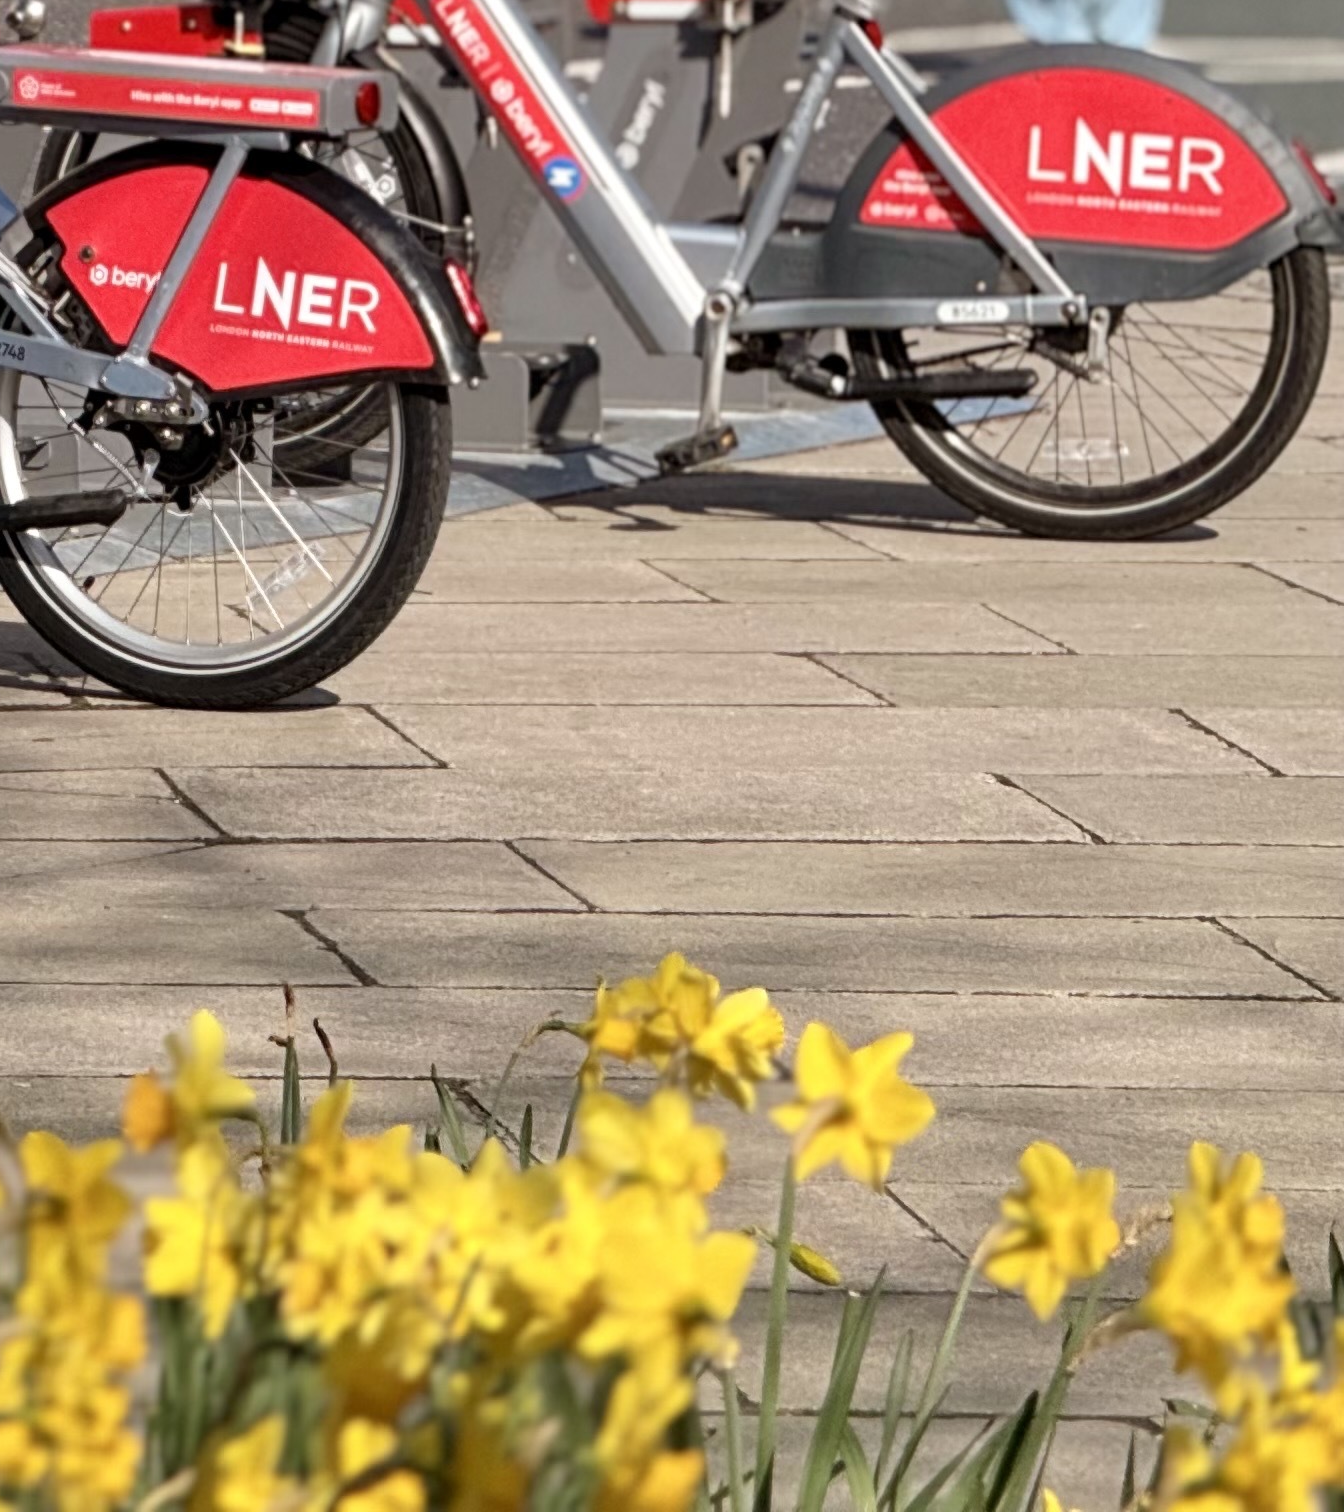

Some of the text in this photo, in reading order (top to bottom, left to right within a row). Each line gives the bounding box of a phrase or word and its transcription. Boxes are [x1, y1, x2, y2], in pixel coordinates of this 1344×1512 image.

[507, 98, 553, 159] beryl
[1028, 116, 1225, 196] LNER
[214, 255, 380, 333] LNER
[209, 323, 374, 353] LONDON NORTH EASTERN RAILWAY
